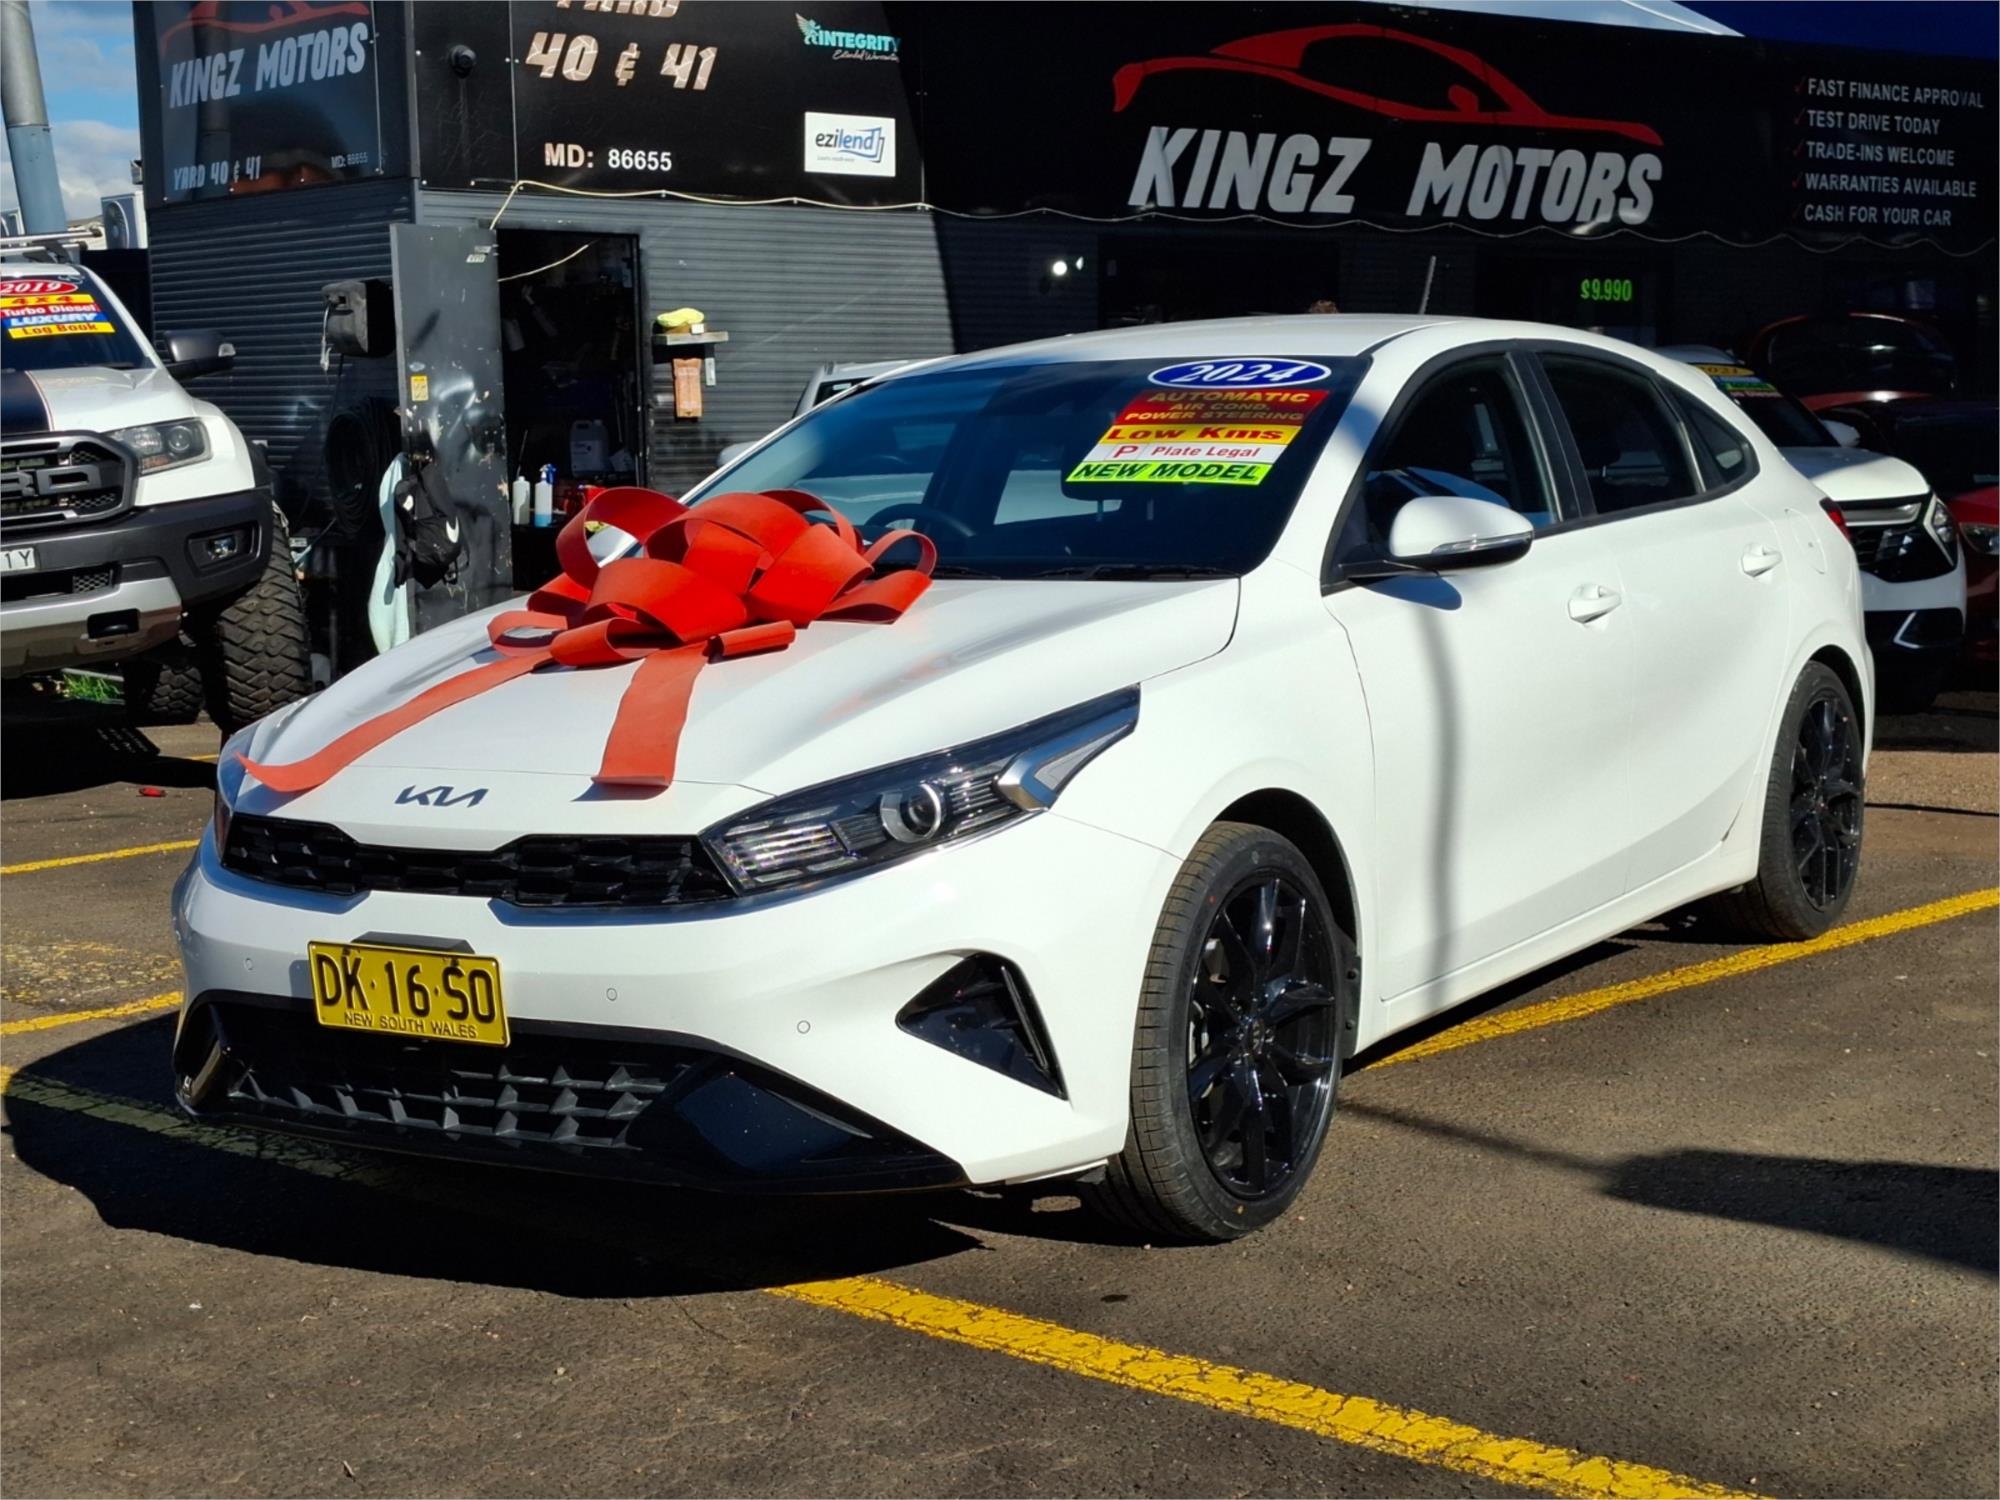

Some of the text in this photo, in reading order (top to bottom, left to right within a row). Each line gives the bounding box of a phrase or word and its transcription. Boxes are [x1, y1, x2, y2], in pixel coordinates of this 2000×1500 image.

[819, 30, 901, 52] INTEGRITY
[170, 22, 368, 109] KINGZ MOTORS
[526, 32, 718, 90] 40 & 41
[1808, 78, 1984, 108] FAST FINANCE APPROVAL
[1807, 110, 1940, 135] TEST DRIVE TODAY
[815, 127, 876, 150] ezilend
[545, 142, 672, 171] MD: 86655
[1806, 141, 1955, 166] TRADE-INS WELCOME
[173, 163, 205, 190] YARD
[211, 162, 229, 184] 40
[246, 156, 261, 180] 41
[1128, 126, 1663, 225] KINGZ MOTORS
[1805, 173, 1976, 198] WARRANTIES AVAILABLE
[1804, 204, 1951, 226] CASH FOR YOUR CAR
[1, 282, 62, 293] 2019
[2, 303, 96, 317] Turbo Diesel
[10, 313, 97, 326] LUXURY
[22, 323, 98, 336] Log Book
[1170, 363, 1307, 383] 2024
[1148, 391, 1310, 402] AUTOMATIC
[1125, 411, 1304, 421] POWER STEERING
[1107, 427, 1284, 440] Low Kms
[1112, 445, 1261, 459] P Plate Legal
[1073, 463, 1260, 480] NEW MODEL
[344, 1011, 477, 1038] NEW SOUTH WALES
